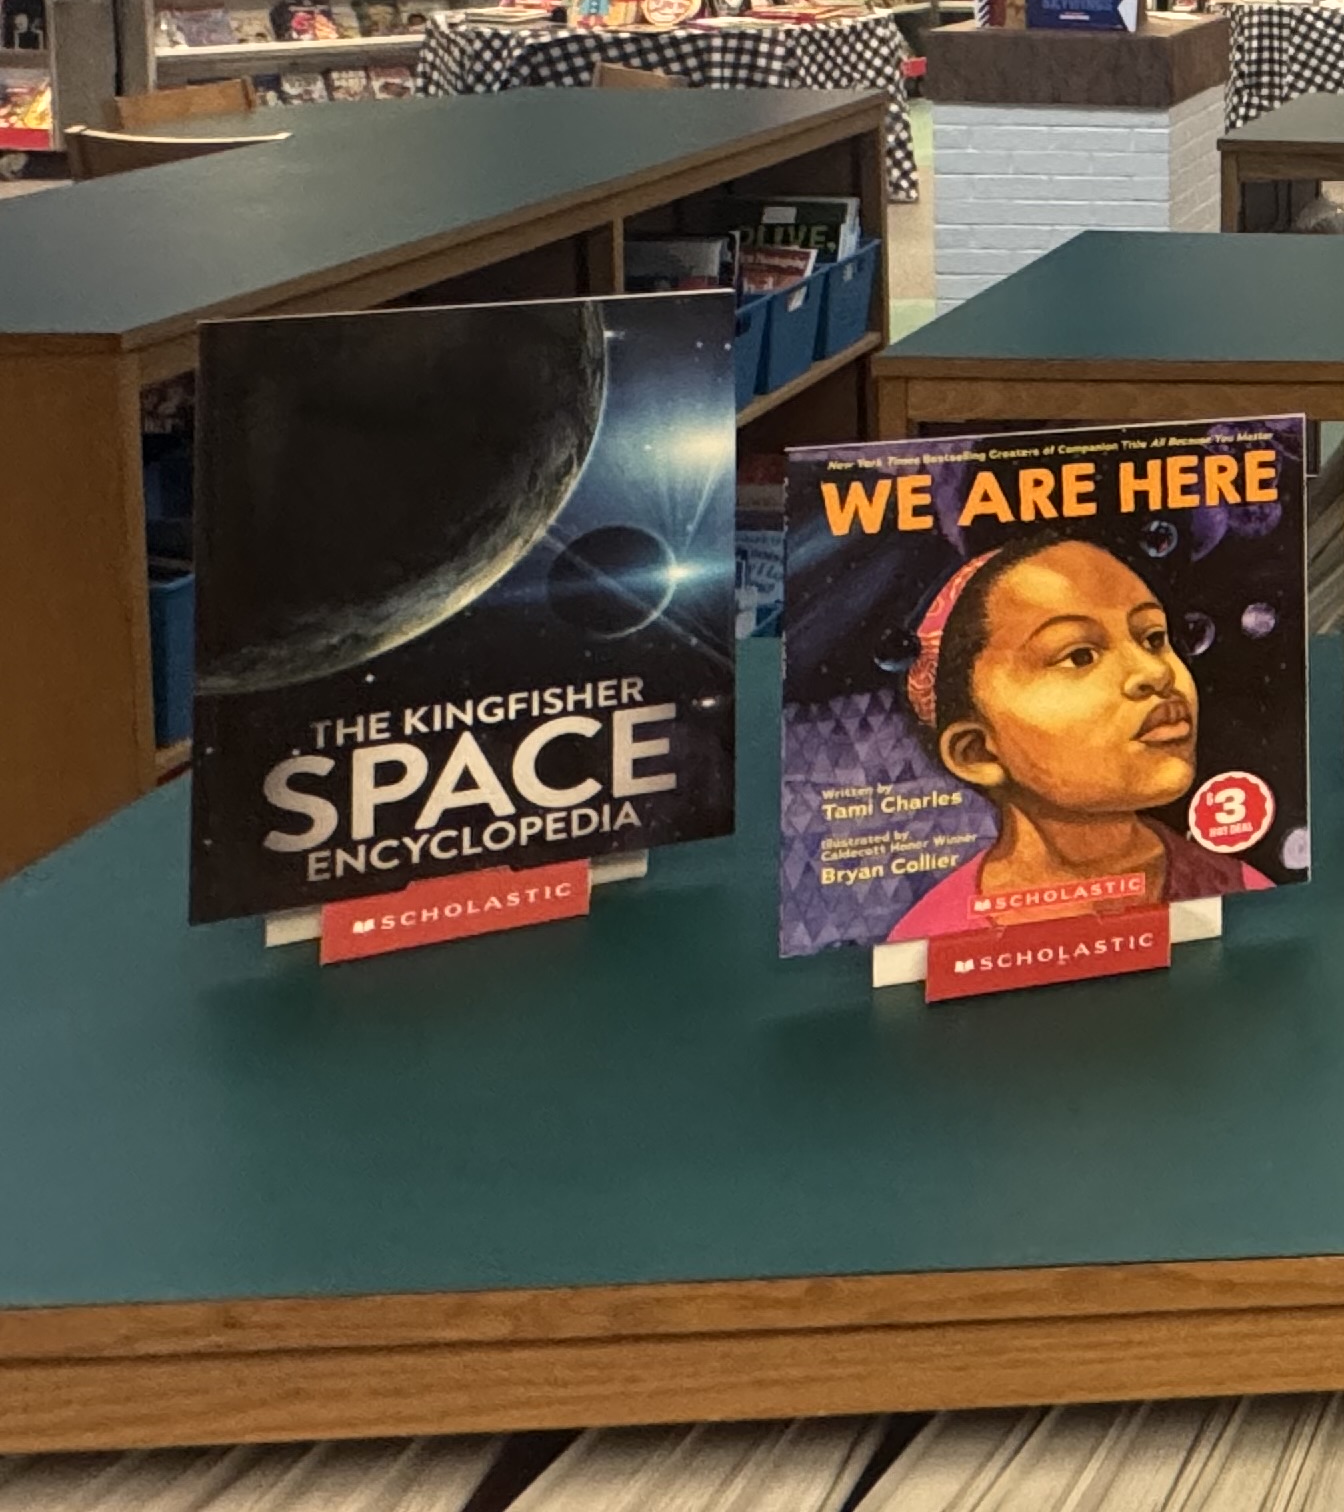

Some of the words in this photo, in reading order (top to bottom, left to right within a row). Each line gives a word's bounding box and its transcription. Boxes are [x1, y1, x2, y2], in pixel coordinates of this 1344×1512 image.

[821, 474, 933, 536] WE
[957, 463, 1097, 526] ARE
[1119, 450, 1278, 513] HERE
[311, 710, 391, 749] THE
[403, 677, 645, 736] KINGFISHER
[262, 703, 678, 853] SPACE
[822, 787, 874, 800] Written
[877, 782, 893, 795] by
[822, 799, 874, 821] Tami
[881, 790, 963, 814] Charles
[307, 801, 642, 881] ENCYCLOPEDIA
[821, 831, 890, 850] Illustrated
[821, 845, 886, 862] Caldecott
[891, 840, 929, 853] Honor
[821, 864, 884, 885] Bryan
[891, 853, 960, 875] Collier
[381, 881, 573, 931] SCHOLASTIC
[995, 877, 1143, 911] SCHOLASTIC
[979, 933, 1154, 972] SCHOLASTIC
